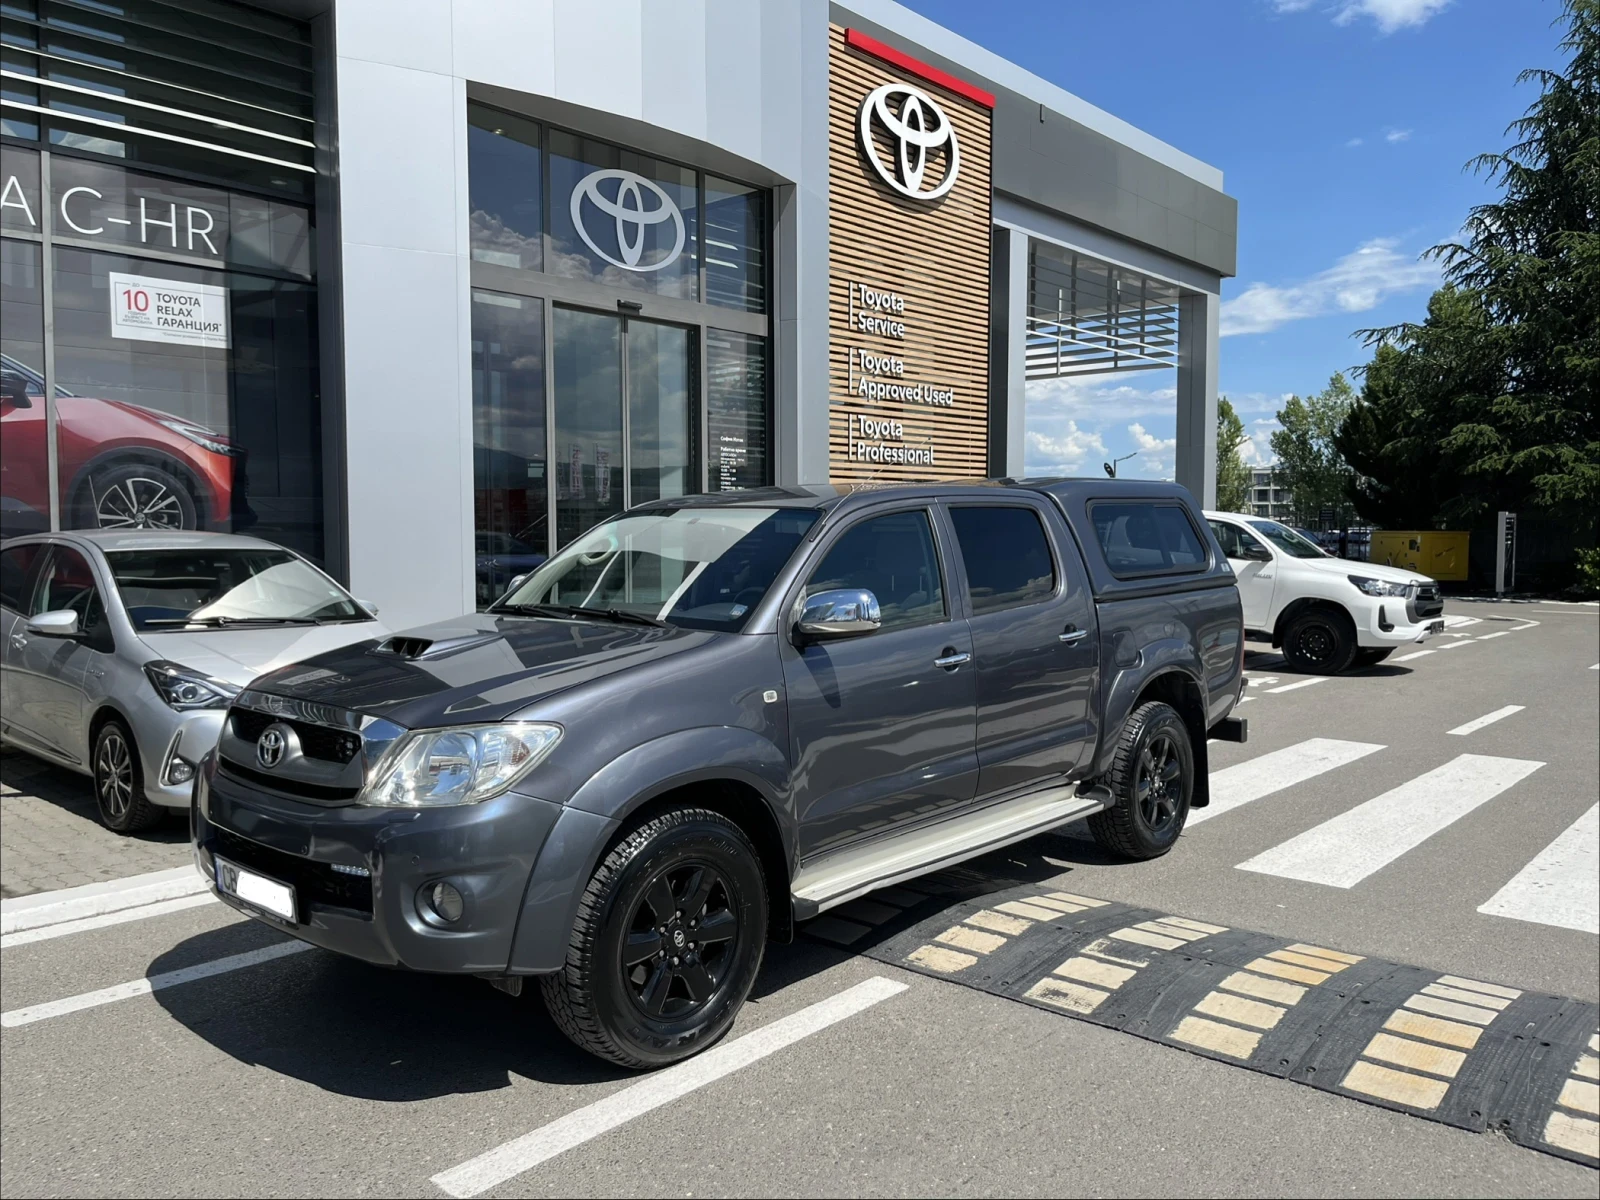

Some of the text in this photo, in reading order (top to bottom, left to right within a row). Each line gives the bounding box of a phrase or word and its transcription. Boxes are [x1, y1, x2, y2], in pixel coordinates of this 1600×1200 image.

[60, 186, 219, 255] C-HR
[123, 289, 149, 312] 10
[156, 292, 201, 307] TOYOTA
[858, 283, 904, 311] Toyota
[157, 305, 193, 318] RELAX
[858, 311, 905, 337] Service
[858, 349, 904, 376] Toyota
[858, 377, 953, 405] Approved Used
[858, 415, 903, 440] Toyota
[857, 441, 935, 466] Professional
